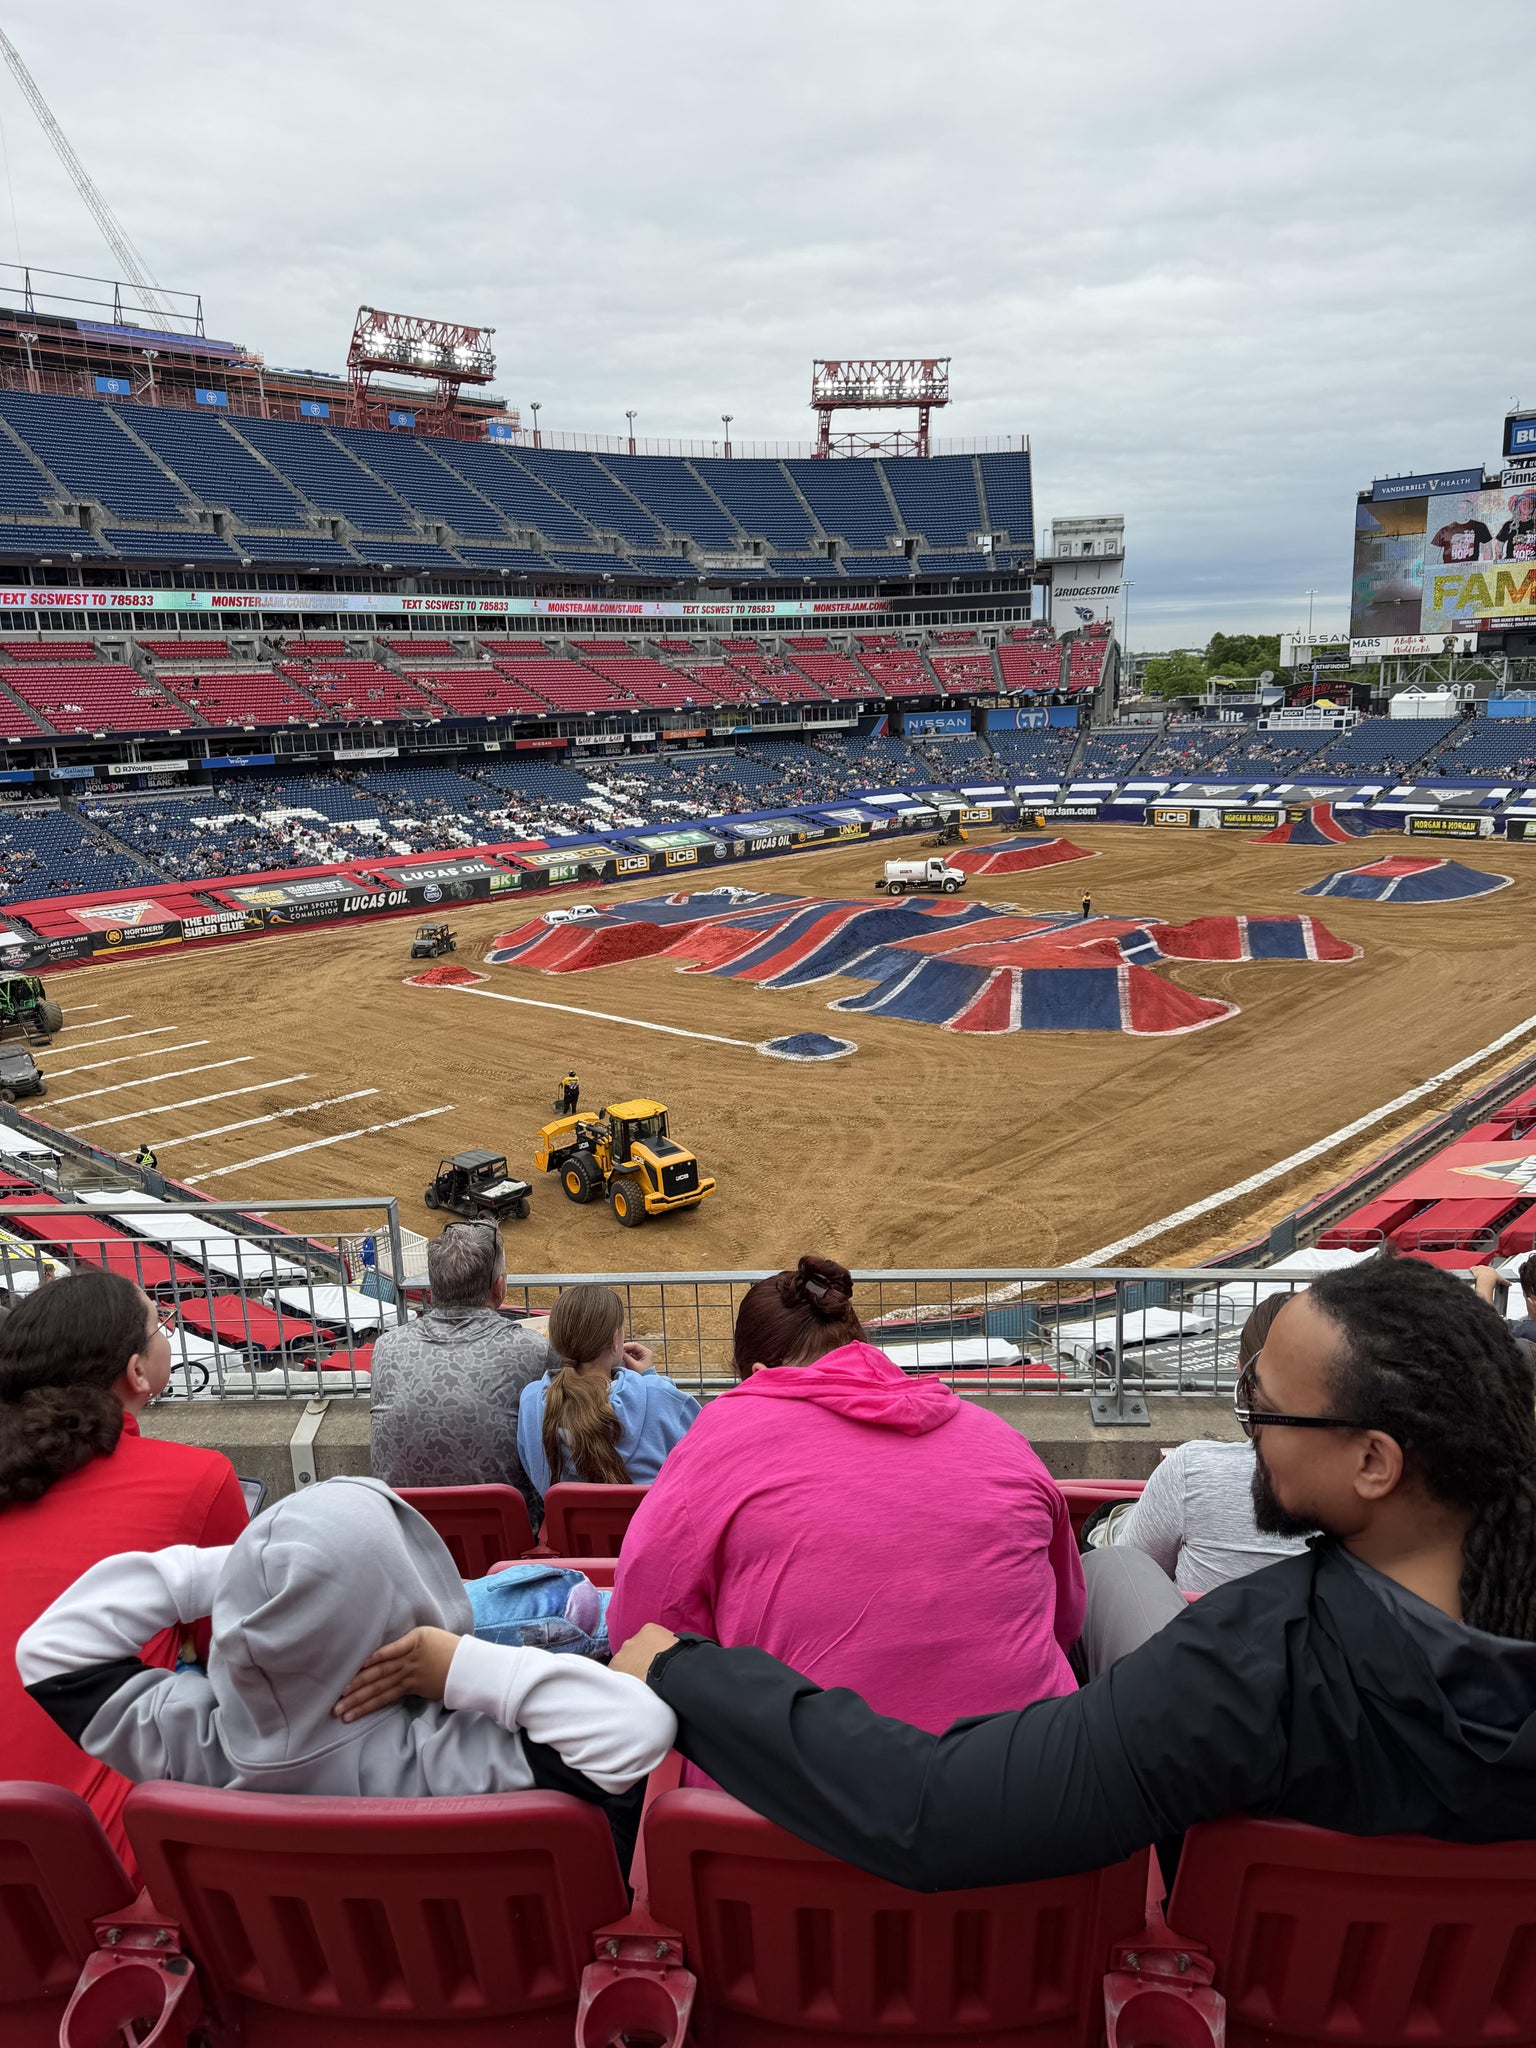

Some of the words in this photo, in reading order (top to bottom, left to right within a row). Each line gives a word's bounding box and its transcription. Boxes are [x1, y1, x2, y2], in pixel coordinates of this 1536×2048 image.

[1381, 483, 1426, 494] VANDERBILT
[1440, 478, 1471, 487] HEALTH
[1054, 585, 1120, 597] BRIDGESTONE
[0, 593, 26, 606] TEXT
[30, 593, 90, 606] SCSWEST
[91, 594, 107, 606] TO
[110, 595, 154, 606] 785833
[401, 599, 423, 610] TEXT
[425, 599, 464, 611] SCSWEST
[466, 600, 477, 611] TO
[479, 601, 509, 612] 785833
[547, 602, 643, 614] MONSTERJAM.COM/STJUDE
[682, 604, 699, 614] TEXT
[701, 604, 734, 614] SCSWEST
[736, 605, 745, 614] TO
[747, 605, 775, 614] 785833
[1291, 634, 1350, 645] NISSAN
[1352, 638, 1381, 648] MARS
[1311, 662, 1349, 671] PATHFINDER
[1220, 710, 1244, 722] lite
[909, 718, 967, 729] NISSAN
[816, 732, 843, 740] TITANS
[64, 767, 93, 775] Gallagher
[122, 765, 153, 773] RJYoung
[147, 779, 174, 788] BLAND
[962, 810, 989, 820] JCB
[1157, 812, 1188, 823] JCB
[1224, 814, 1246, 822] MORGAN
[839, 823, 862, 835] UNOH
[1414, 820, 1441, 829] MORGAN
[1441, 821, 1447, 829] &
[1447, 821, 1476, 831] MORGAN
[751, 837, 777, 851] LUCAS
[669, 849, 695, 864] JCB
[619, 856, 647, 871] JCB
[400, 867, 459, 882] LUCAS
[549, 865, 578, 878] BKT
[490, 874, 521, 888] BKT
[289, 904, 309, 913] UTAH
[311, 900, 338, 910] SPORTS
[343, 892, 385, 912] LUCAS
[183, 916, 203, 928] THE
[204, 911, 249, 925] ORIGINAL
[290, 907, 339, 920] COMMISSION
[124, 924, 164, 936] NORTHERN
[184, 926, 218, 938] SUPER
[220, 922, 245, 934] GLUE
[578, 1141, 589, 1150] JCB
[675, 1173, 689, 1181] JCB
